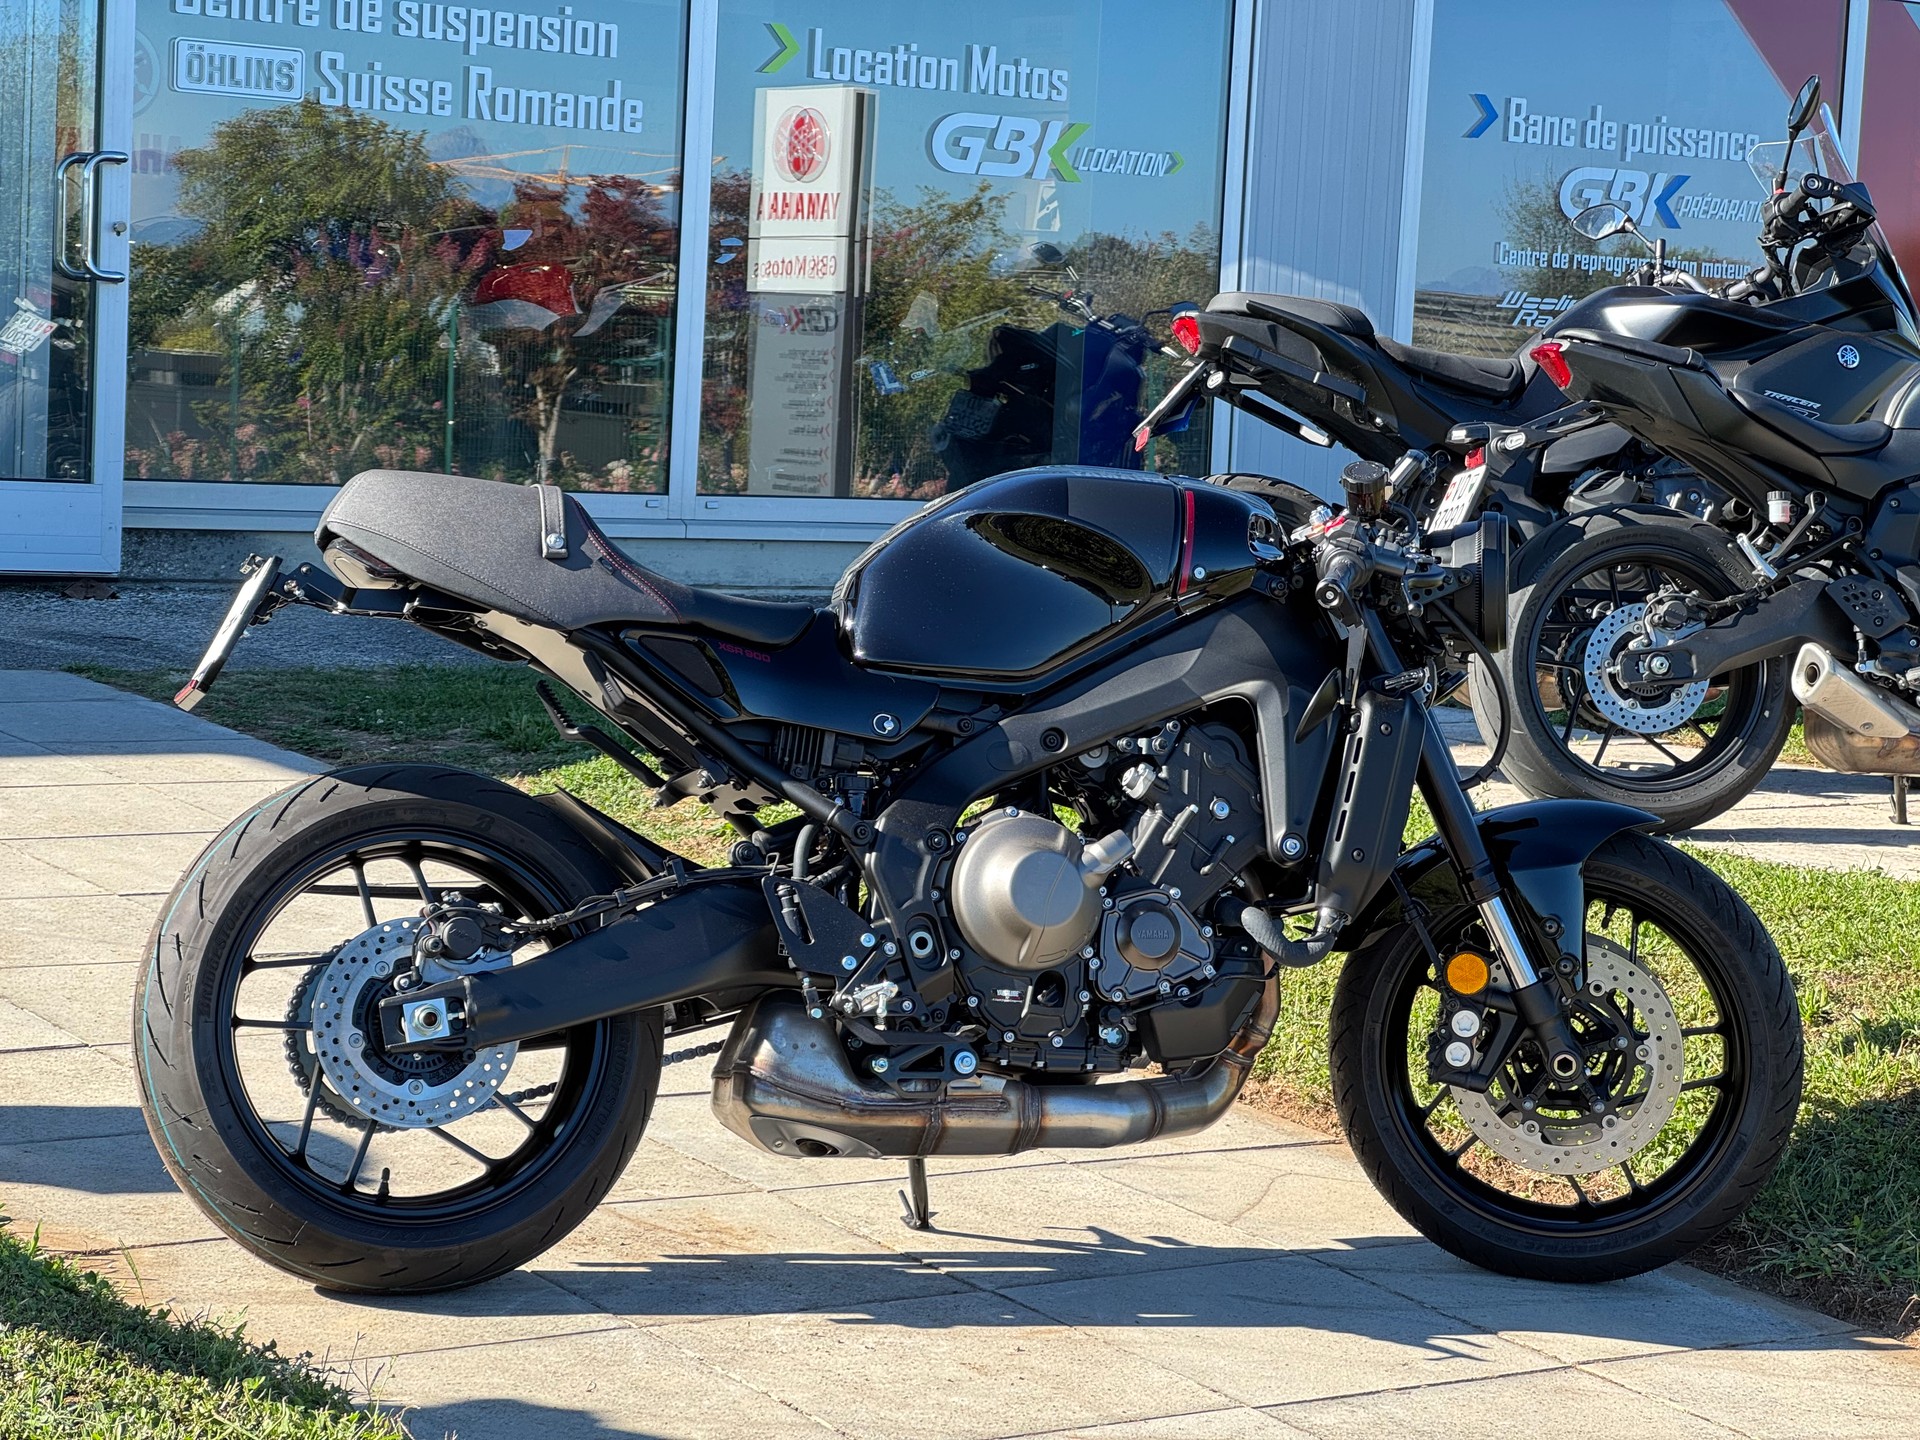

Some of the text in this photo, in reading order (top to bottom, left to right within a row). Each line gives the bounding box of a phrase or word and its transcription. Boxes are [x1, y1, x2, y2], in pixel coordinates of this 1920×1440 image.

[336, 0, 383, 33] de
[398, 1, 619, 58] suspension
[185, 44, 295, 92] ÖHLINS
[319, 50, 644, 133] Suisse Romande
[813, 28, 1069, 101] Location Motos
[931, 112, 1092, 183] GBK
[1507, 97, 1760, 162] Banc de puissance
[1078, 146, 1172, 177] LOCATION
[1559, 166, 1692, 230] GBK
[1499, 241, 1547, 268] Centre
[1551, 245, 1569, 270] de
[1701, 259, 1752, 280] moteur
[1763, 389, 1822, 410] TRACER
[719, 641, 772, 663] XSR 900
[199, 891, 252, 1019] BRIDGESTONE
[1136, 929, 1170, 939] YAMAHA
